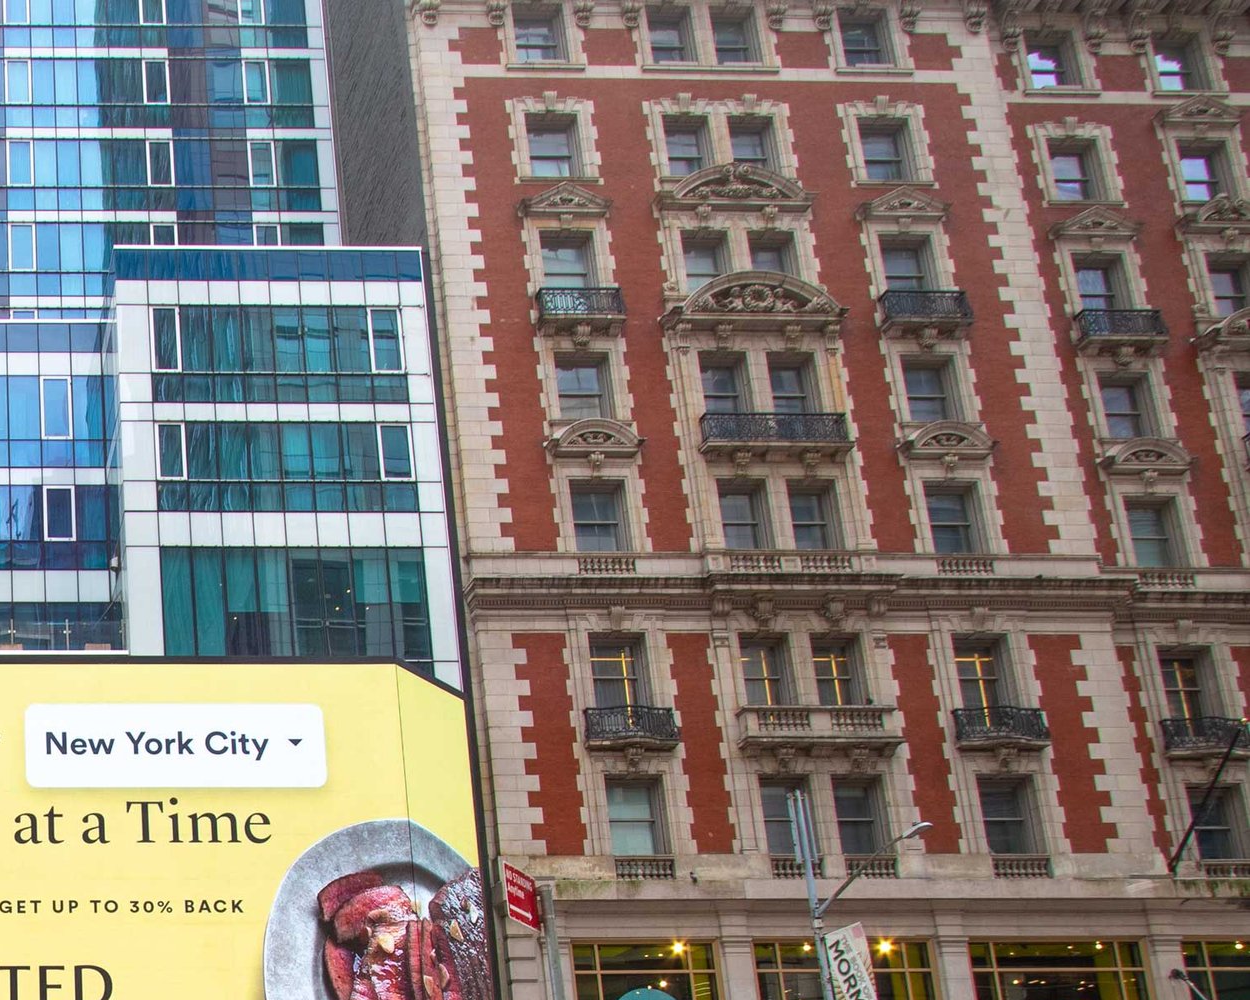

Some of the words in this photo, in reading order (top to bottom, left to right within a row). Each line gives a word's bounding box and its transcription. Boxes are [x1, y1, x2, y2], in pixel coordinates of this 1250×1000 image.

[46, 731, 114, 756] New
[126, 731, 194, 756] York
[205, 731, 268, 761] City
[14, 806, 64, 845] at
[82, 812, 110, 845] a
[126, 797, 272, 844] Time
[0, 900, 41, 914] GET
[53, 900, 79, 914] UP
[90, 900, 118, 914] TO
[130, 900, 172, 914] 30%
[185, 900, 244, 914] BACK
